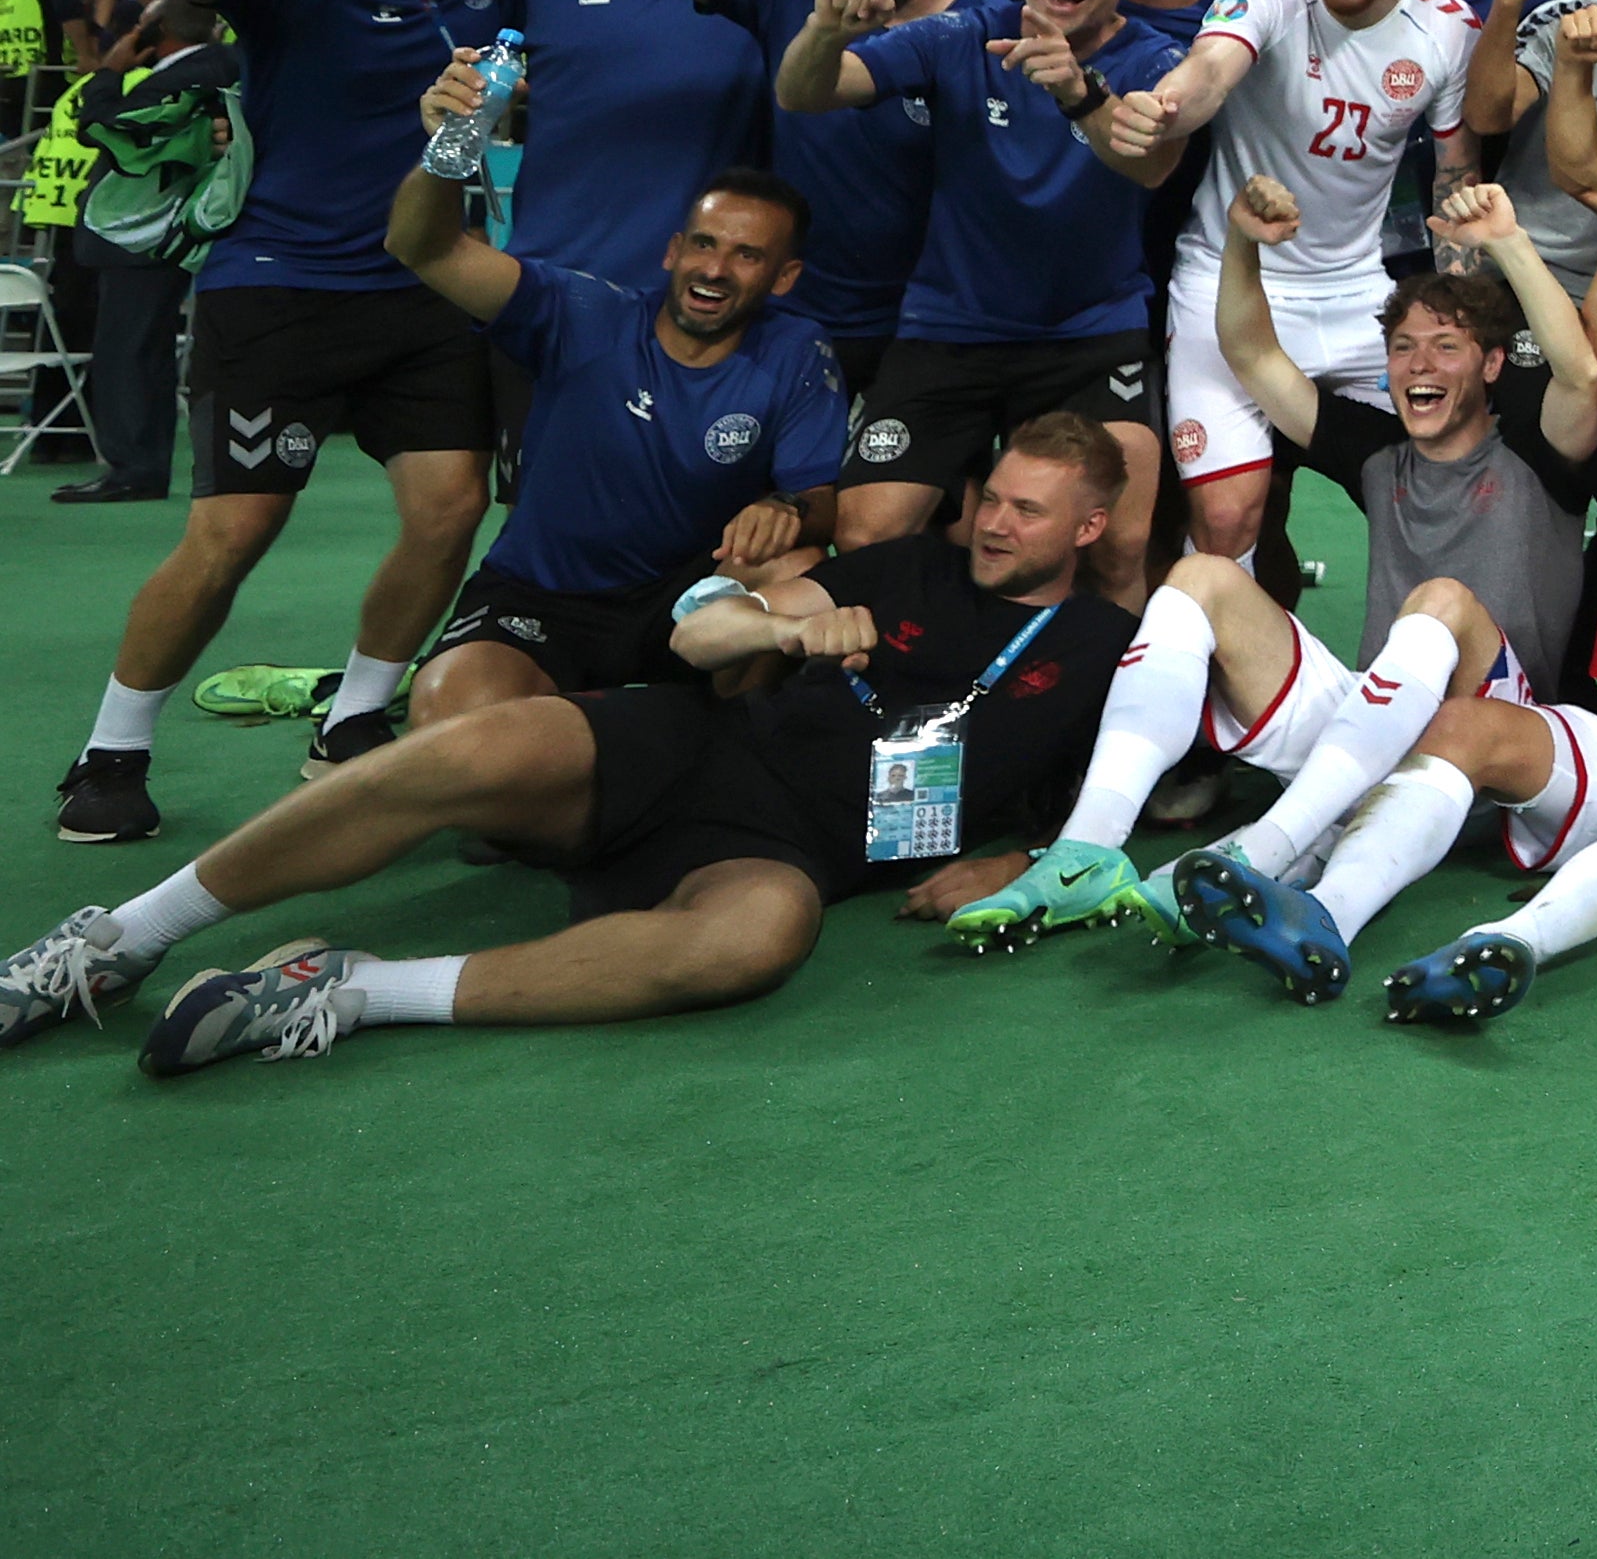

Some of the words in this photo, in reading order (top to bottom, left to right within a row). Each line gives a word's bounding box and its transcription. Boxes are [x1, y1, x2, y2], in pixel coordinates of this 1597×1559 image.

[1391, 73, 1416, 88] DBU
[1308, 97, 1372, 161] 23
[718, 430, 751, 447] DBU
[868, 432, 899, 447] DBU
